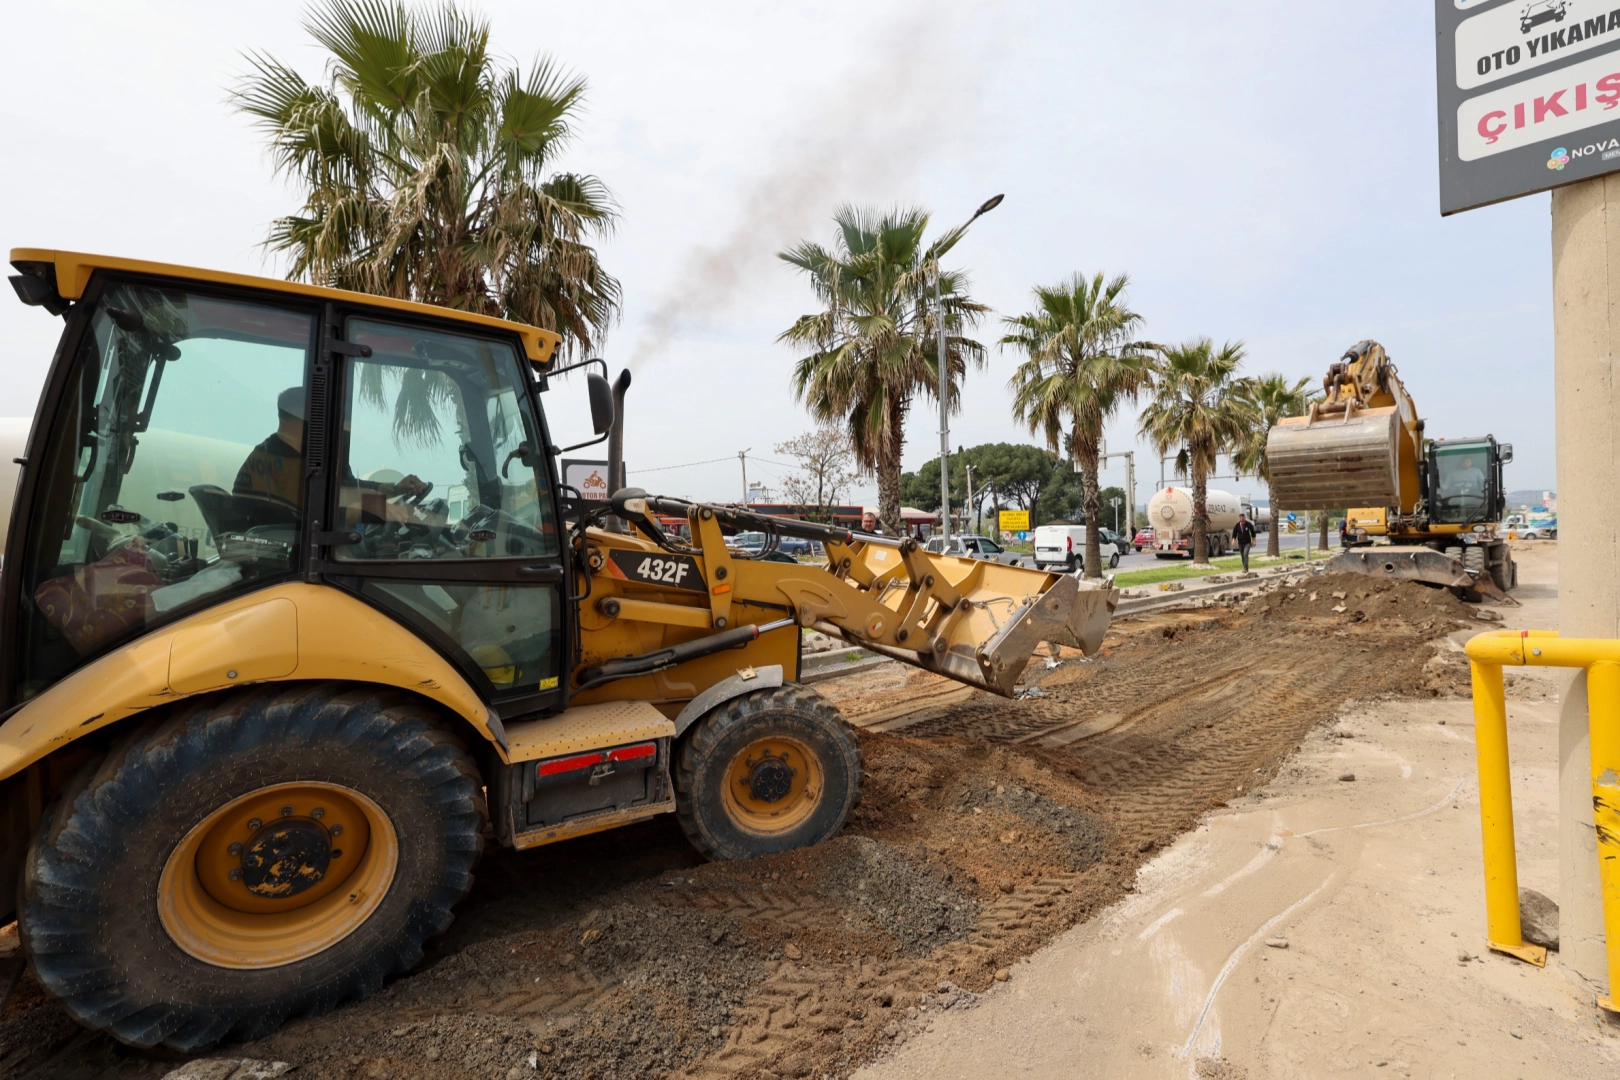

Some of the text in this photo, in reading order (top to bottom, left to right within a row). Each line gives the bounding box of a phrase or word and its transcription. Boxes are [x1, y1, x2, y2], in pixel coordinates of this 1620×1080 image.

[1477, 9, 1620, 75] OTO YIKAMA
[1477, 72, 1620, 145] ÇIKIŞ
[1571, 138, 1619, 159] NOVA
[637, 557, 689, 584] 432F
